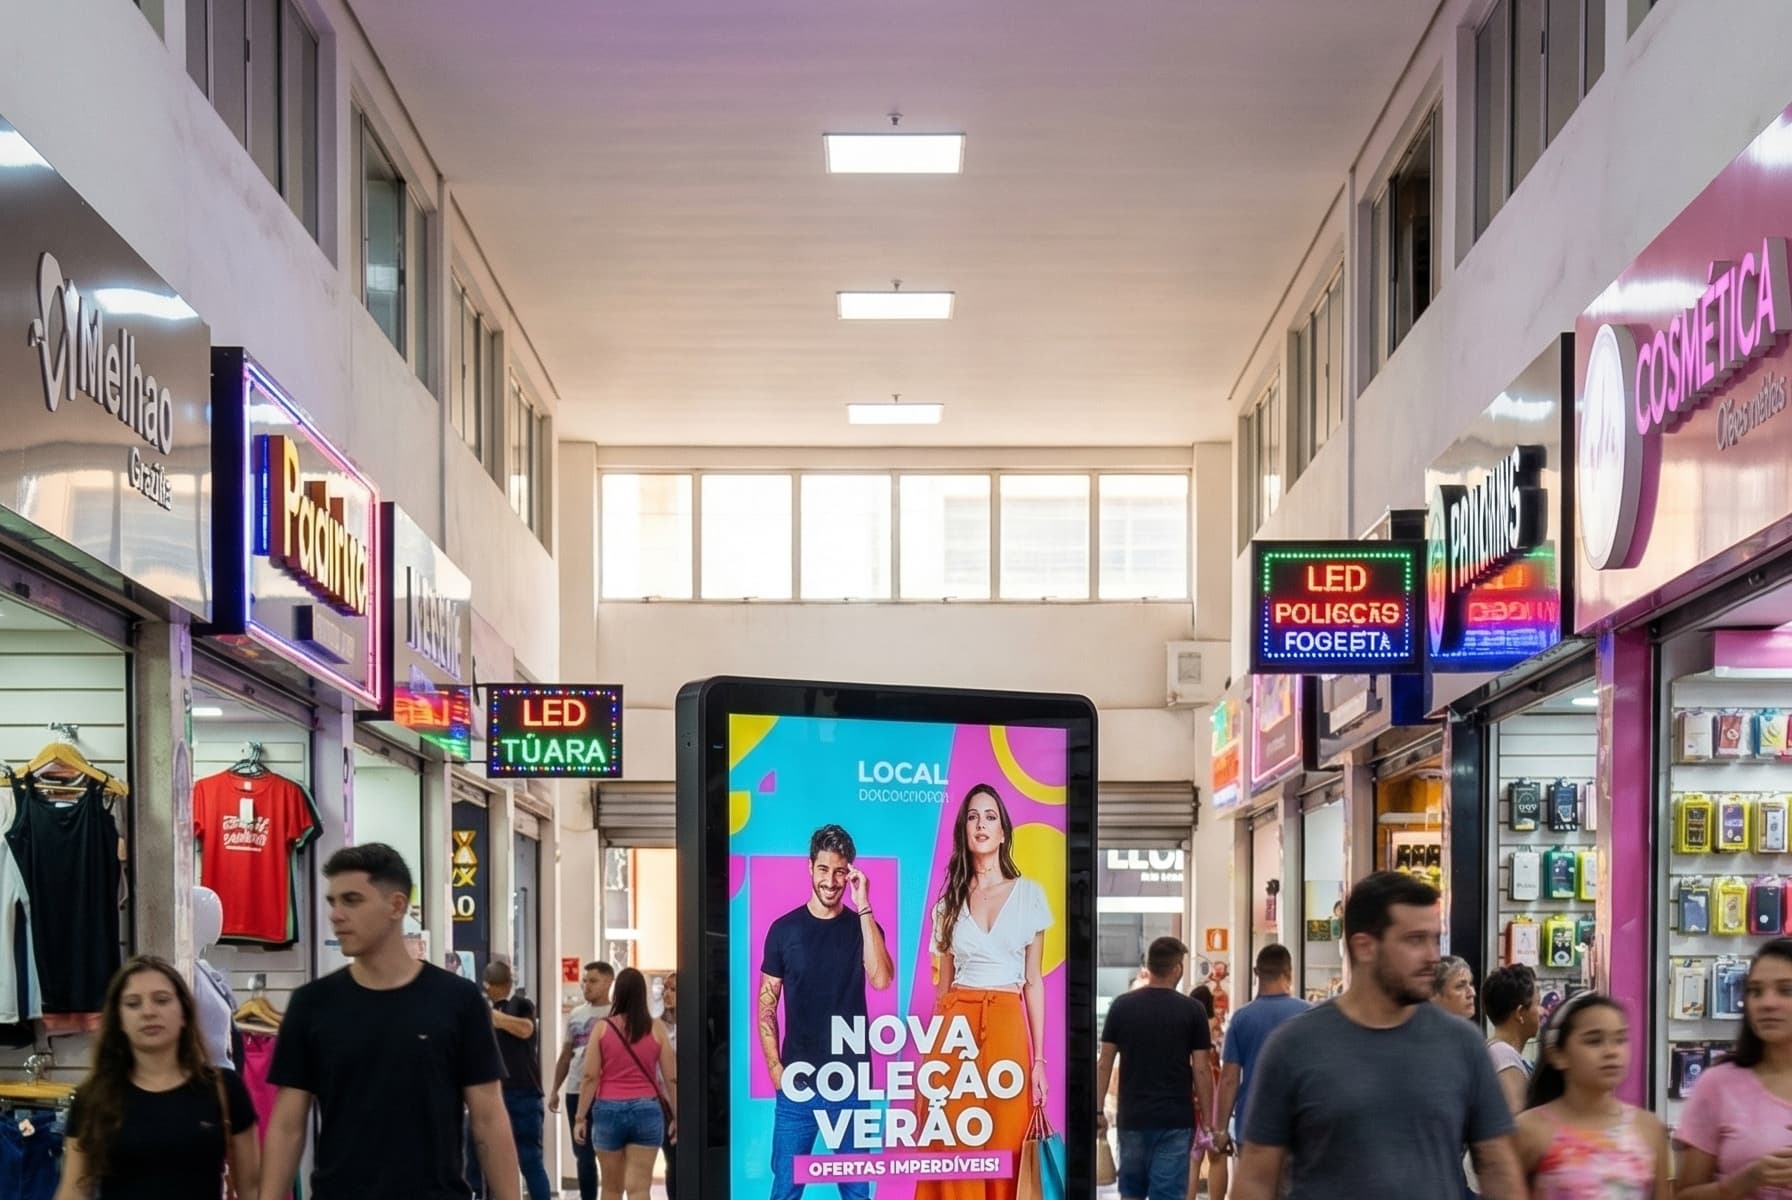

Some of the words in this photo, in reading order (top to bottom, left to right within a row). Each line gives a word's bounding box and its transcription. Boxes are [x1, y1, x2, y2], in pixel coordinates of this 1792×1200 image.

[1634, 237, 1777, 435] COSMÉTICA
[1307, 564, 1367, 592] LED
[522, 699, 587, 727] LED
[858, 760, 949, 785] LOCAL
[830, 1015, 979, 1056] NOVA
[781, 1050, 1025, 1107] COLEÇÃO
[808, 1159, 886, 1177] OFERTAS
[889, 1155, 1000, 1175] IMPERDÍVEIS!
